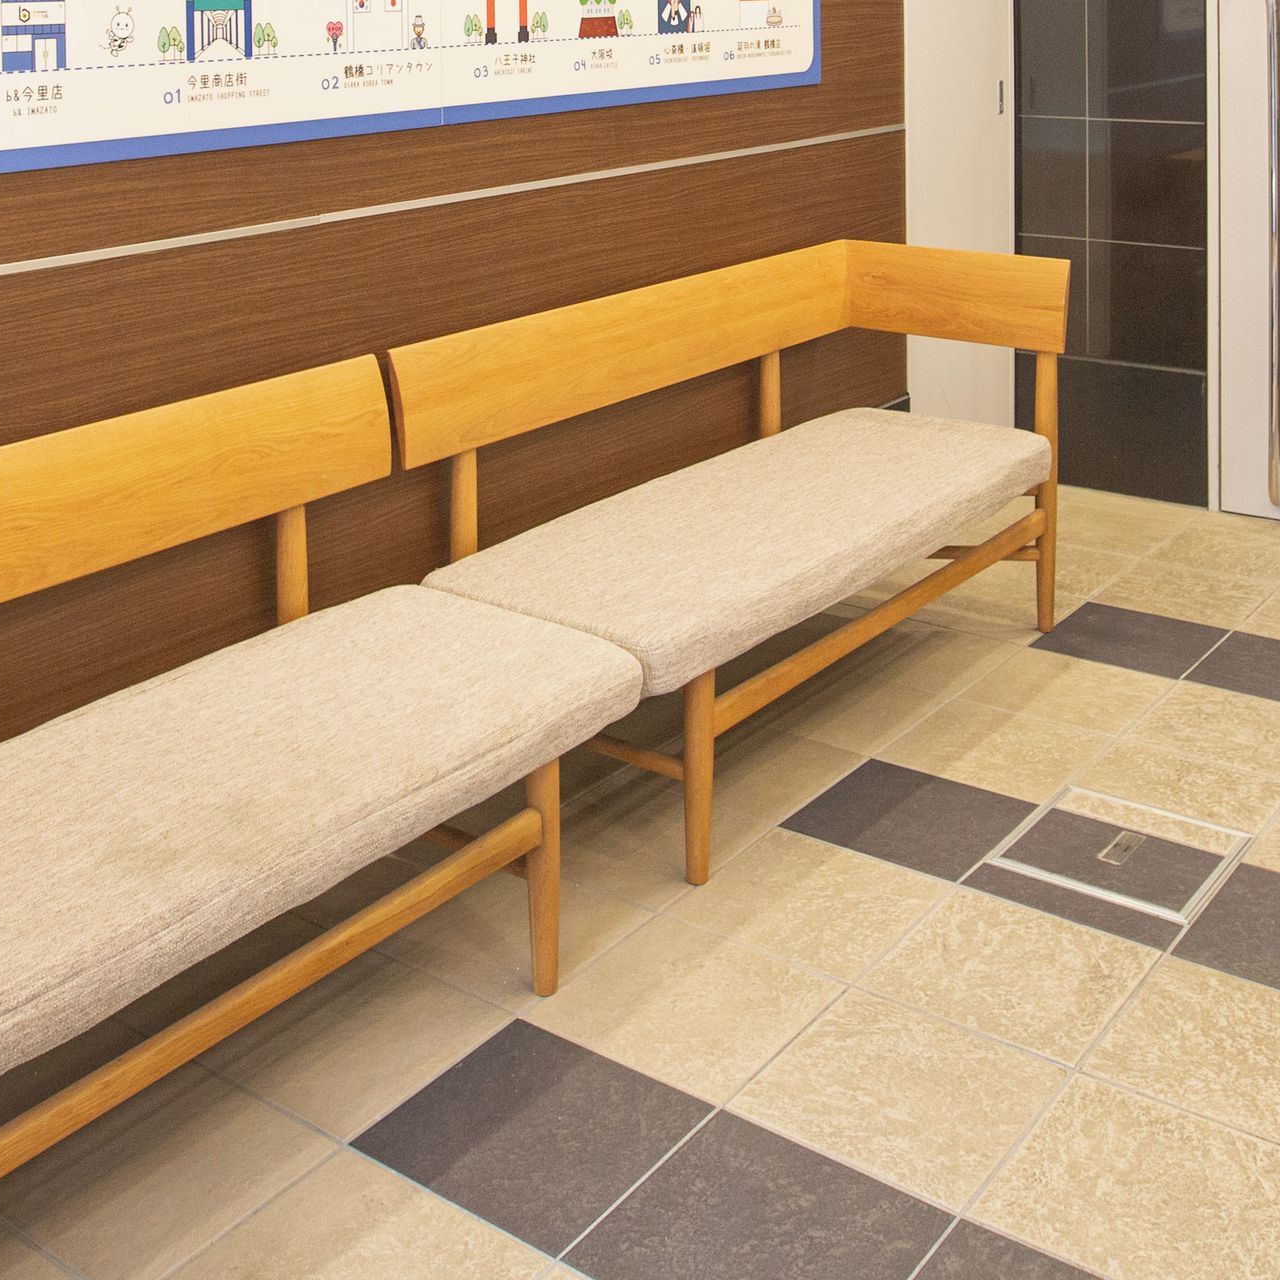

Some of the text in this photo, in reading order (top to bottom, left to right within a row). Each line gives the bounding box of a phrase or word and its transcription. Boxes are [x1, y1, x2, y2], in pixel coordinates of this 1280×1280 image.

[648, 53, 661, 66] 05
[723, 50, 735, 61] 06
[473, 65, 489, 78] 03
[573, 59, 586, 71] 04
[187, 72, 248, 90] 今里商店街
